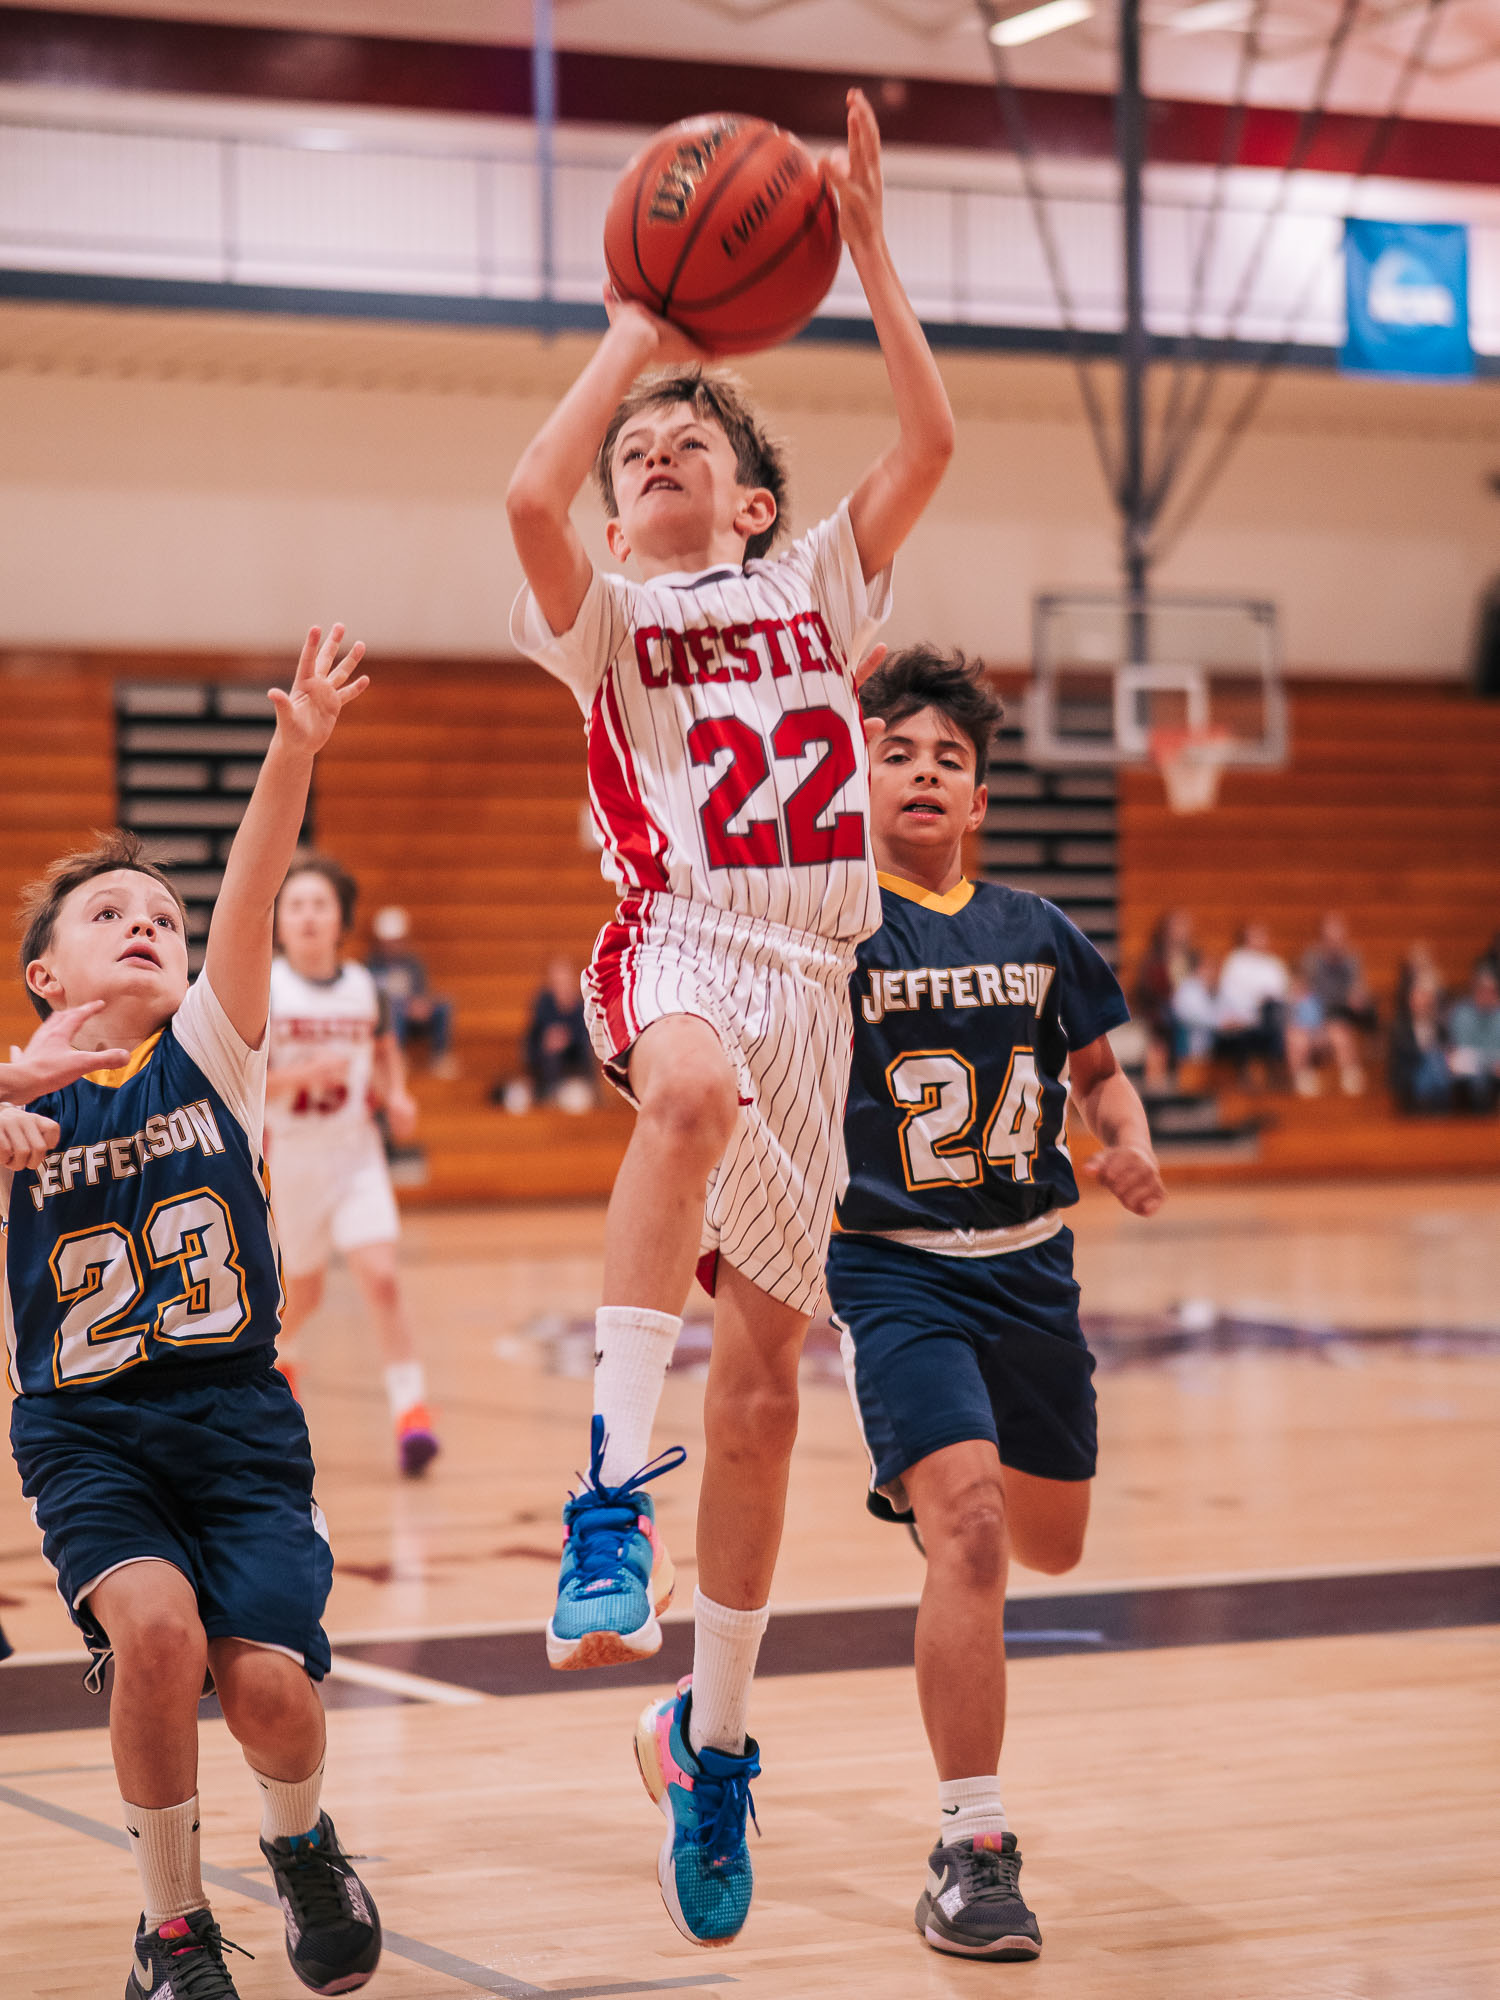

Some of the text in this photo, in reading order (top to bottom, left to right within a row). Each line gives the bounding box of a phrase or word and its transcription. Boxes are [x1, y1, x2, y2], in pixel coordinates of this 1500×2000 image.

[687, 705, 866, 870] 22
[885, 1046, 1043, 1192] 24
[48, 1186, 251, 1389] 23
